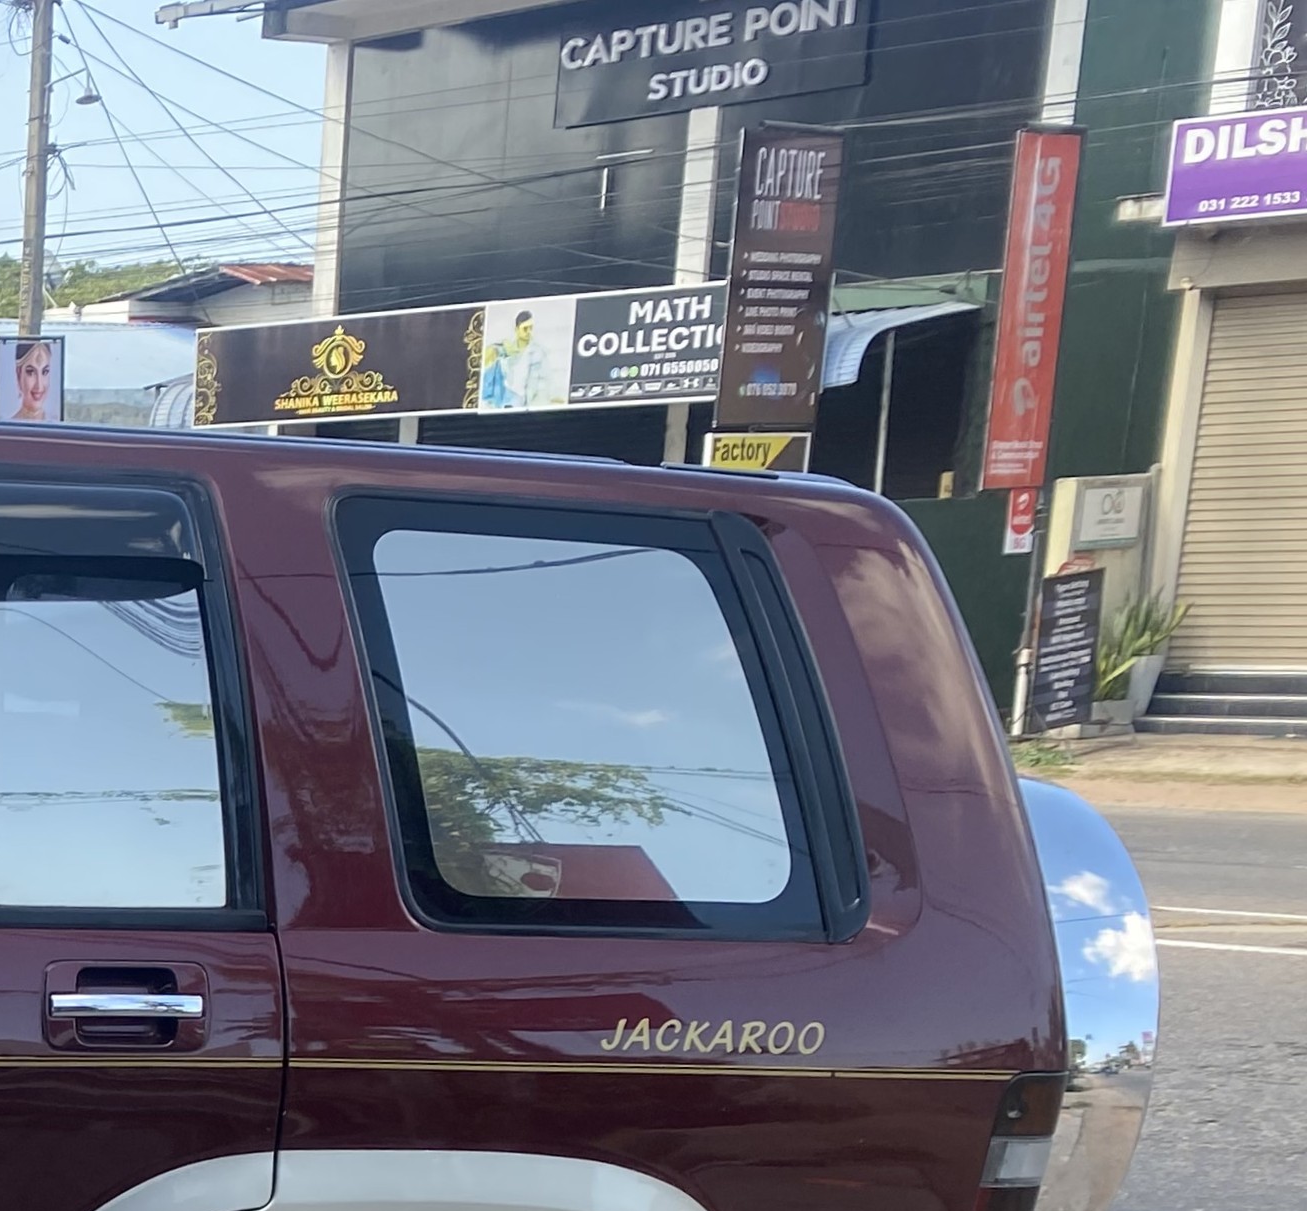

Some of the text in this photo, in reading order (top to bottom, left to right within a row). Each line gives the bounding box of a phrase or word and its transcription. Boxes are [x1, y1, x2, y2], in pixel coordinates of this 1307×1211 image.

[560, 0, 858, 70] CAPTURE POINT
[647, 58, 770, 101] STUDIO
[1183, 116, 1307, 164] DILSH
[754, 146, 826, 200] CAPTURE
[1197, 191, 1301, 213] 031 222 1533
[1017, 155, 1062, 368] airtel 4G
[628, 295, 713, 325] MATH
[639, 362, 661, 376] 071
[273, 390, 399, 411] SHANIKA WEERASEKARA
[712, 437, 772, 467] Factory
[599, 1017, 826, 1055] JACKAROO
